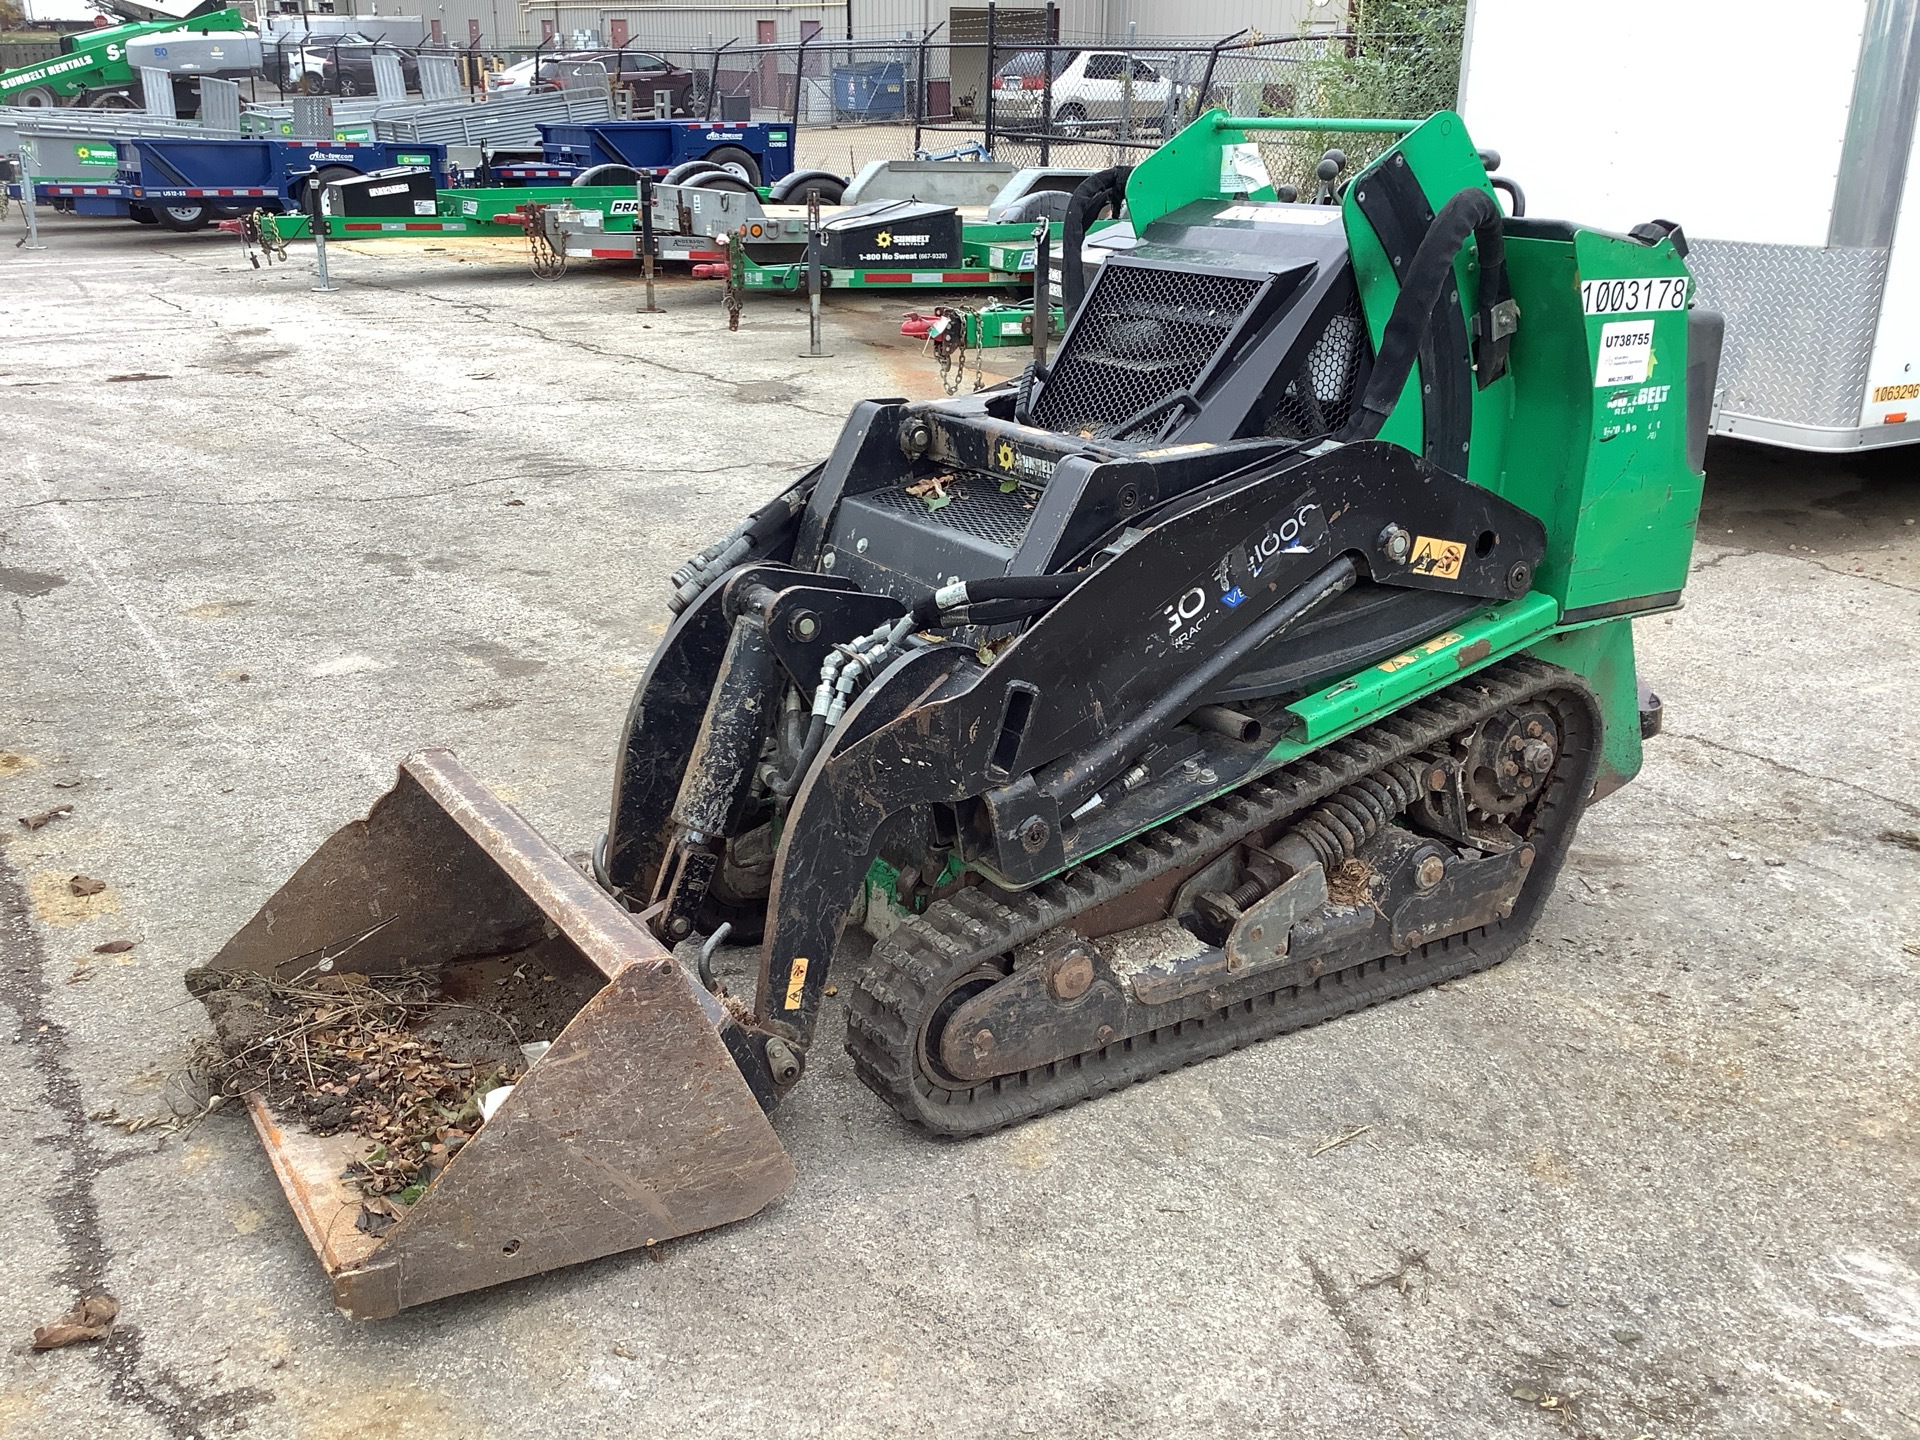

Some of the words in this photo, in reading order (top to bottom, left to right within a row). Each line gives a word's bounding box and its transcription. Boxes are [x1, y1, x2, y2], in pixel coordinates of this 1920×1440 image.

[154, 48, 168, 57] 50
[0, 68, 47, 90] SUNBELT
[46, 54, 94, 76] RENTALS
[892, 234, 931, 243] SUNBELT
[881, 252, 893, 260] No
[893, 252, 918, 260] Sweat
[1583, 278, 1686, 313] 1003178
[1605, 333, 1650, 348] U738755
[1874, 383, 1920, 402] 1063296
